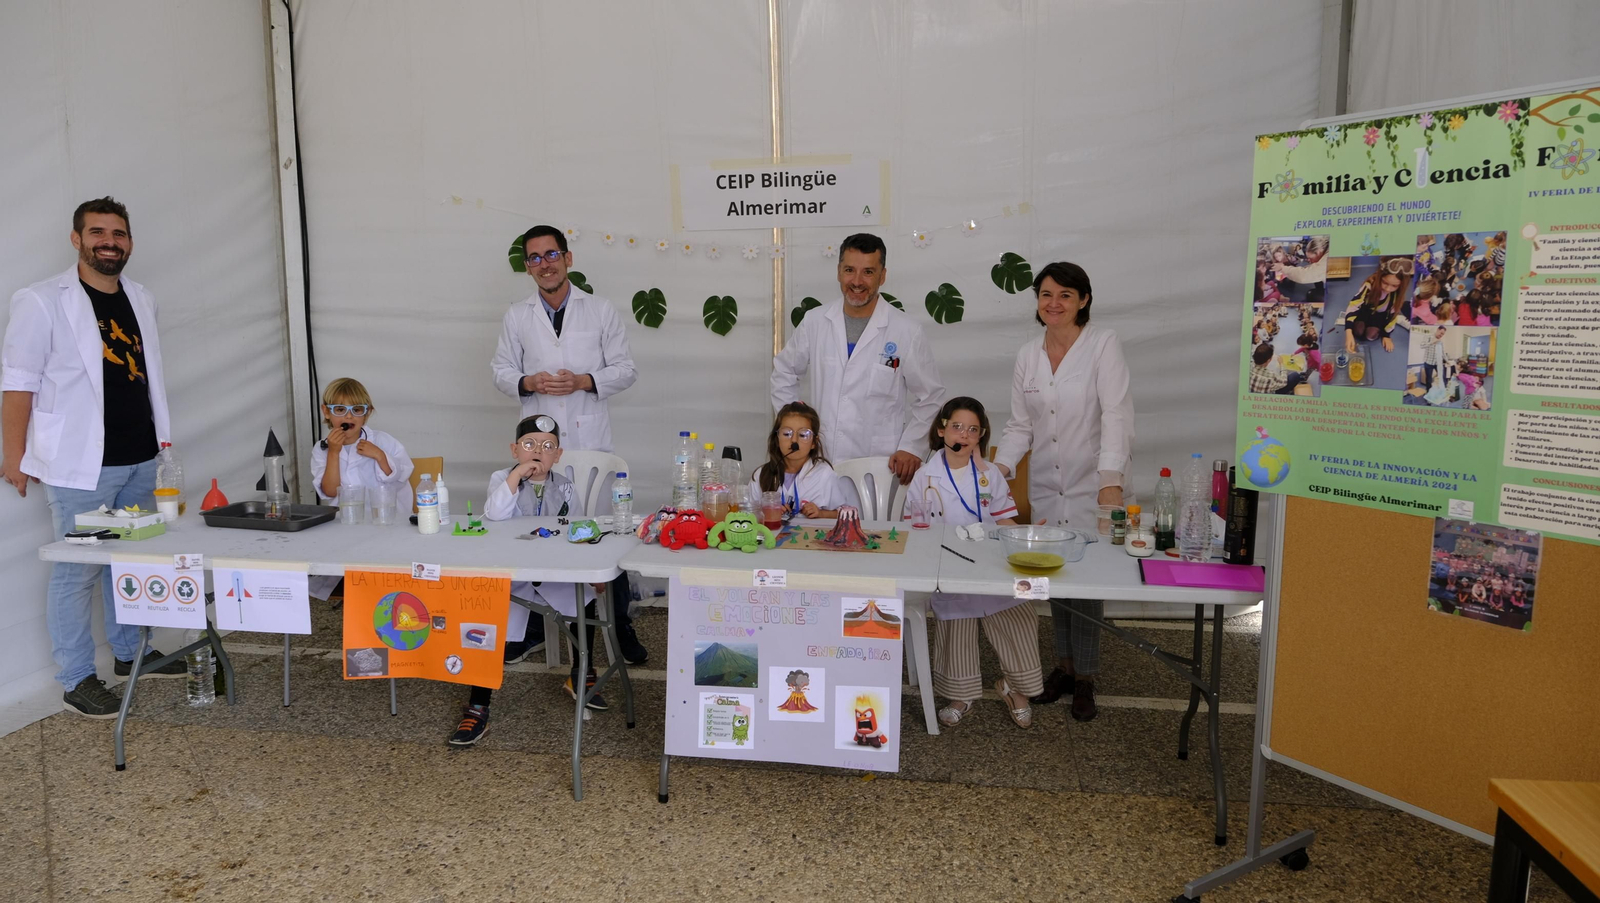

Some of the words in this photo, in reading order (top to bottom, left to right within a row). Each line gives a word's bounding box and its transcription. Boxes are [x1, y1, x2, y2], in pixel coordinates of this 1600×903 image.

[716, 174, 755, 190] CEIP
[761, 171, 837, 191] Bilingüe
[1371, 175, 1388, 194] y
[1542, 188, 1576, 196] FERIA
[727, 199, 827, 217] Almerimar
[1322, 203, 1384, 216] DESCUBRIENDO
[1387, 202, 1398, 212] EL
[1400, 200, 1431, 210] MUNDO
[1337, 214, 1394, 227] EXPERIMENTA
[1396, 214, 1404, 224] Y
[1406, 210, 1462, 222] DIVIÉRTETE!
[1254, 395, 1294, 404] RELACIÓN
[1332, 402, 1368, 410] ESCUELA
[1383, 405, 1449, 417] FUNDAMENTAL
[1451, 411, 1478, 419] PARA
[1252, 404, 1304, 414] DESARROLLO
[1322, 410, 1369, 420] ALUMNADO,
[1371, 414, 1402, 422] SIENDO
[1424, 418, 1478, 429] EXCELENTE
[1243, 412, 1293, 420] ESTRATEGIA
[1318, 417, 1365, 428] DESPERTAR
[1379, 423, 1416, 432] INTERÉS
[1451, 430, 1480, 439] NIÑOS
[1312, 425, 1336, 433] NIÑAS
[1367, 431, 1405, 440] CIENCIA.
[1517, 428, 1569, 436] Fortalecimiento
[1544, 445, 1584, 453] aprendizaje
[1321, 456, 1350, 466] FERIA
[1368, 461, 1380, 470] LA
[1383, 463, 1450, 478] INNOVACIÓN
[1463, 474, 1477, 482] LA
[1559, 462, 1599, 470] habilidades
[1323, 466, 1362, 478] CIENCIA
[1365, 471, 1378, 480] DE
[1381, 474, 1429, 487] ALMERÍA
[1432, 481, 1458, 491] 2024
[1308, 484, 1332, 494] CEIP
[1333, 486, 1377, 502] Bilingüe
[1379, 495, 1442, 512] Almerimar
[1511, 488, 1535, 496] trabajo
[1553, 502, 1584, 511] positivos
[1519, 512, 1563, 523] colaboración
[800, 592, 830, 608] LAS
